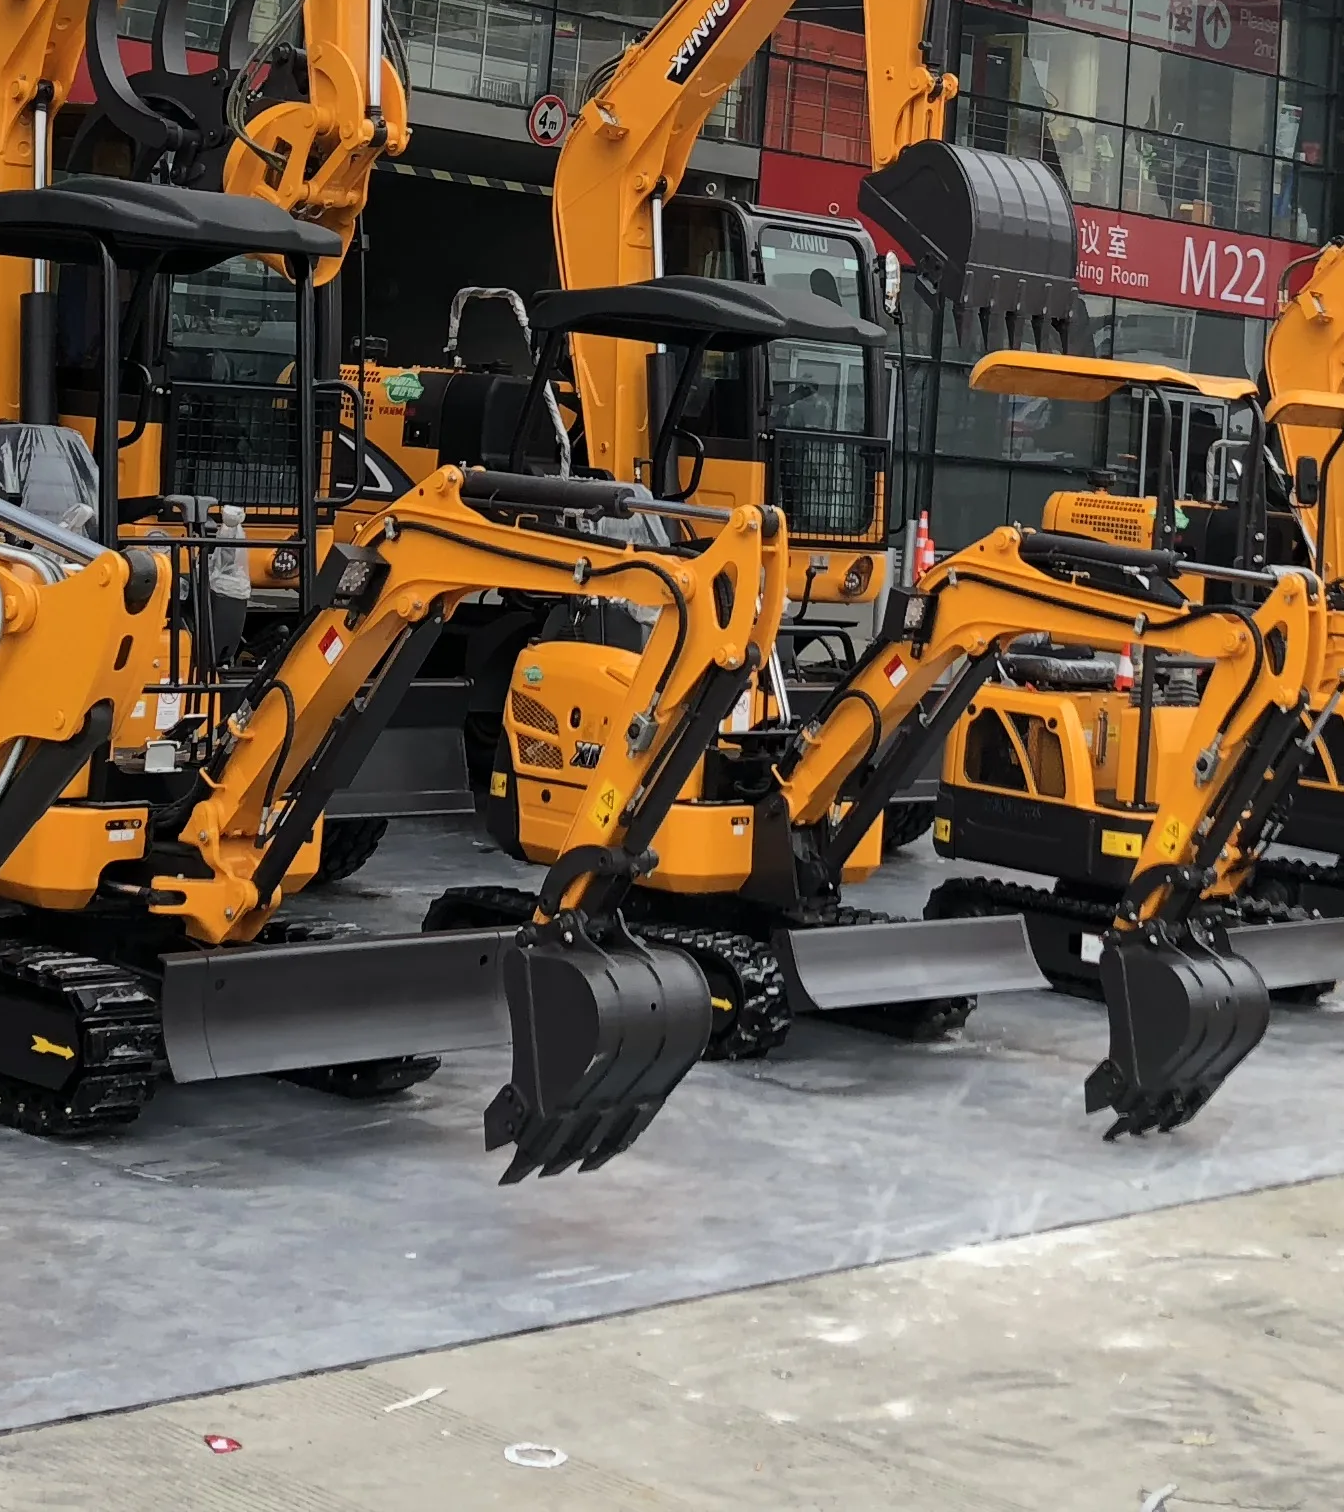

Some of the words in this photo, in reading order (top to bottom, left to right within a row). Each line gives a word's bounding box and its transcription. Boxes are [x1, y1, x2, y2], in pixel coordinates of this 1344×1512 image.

[789, 232, 830, 254] XINIU
[1080, 218, 1129, 260] 议室
[1180, 236, 1266, 306] M22
[1111, 264, 1149, 287] Room
